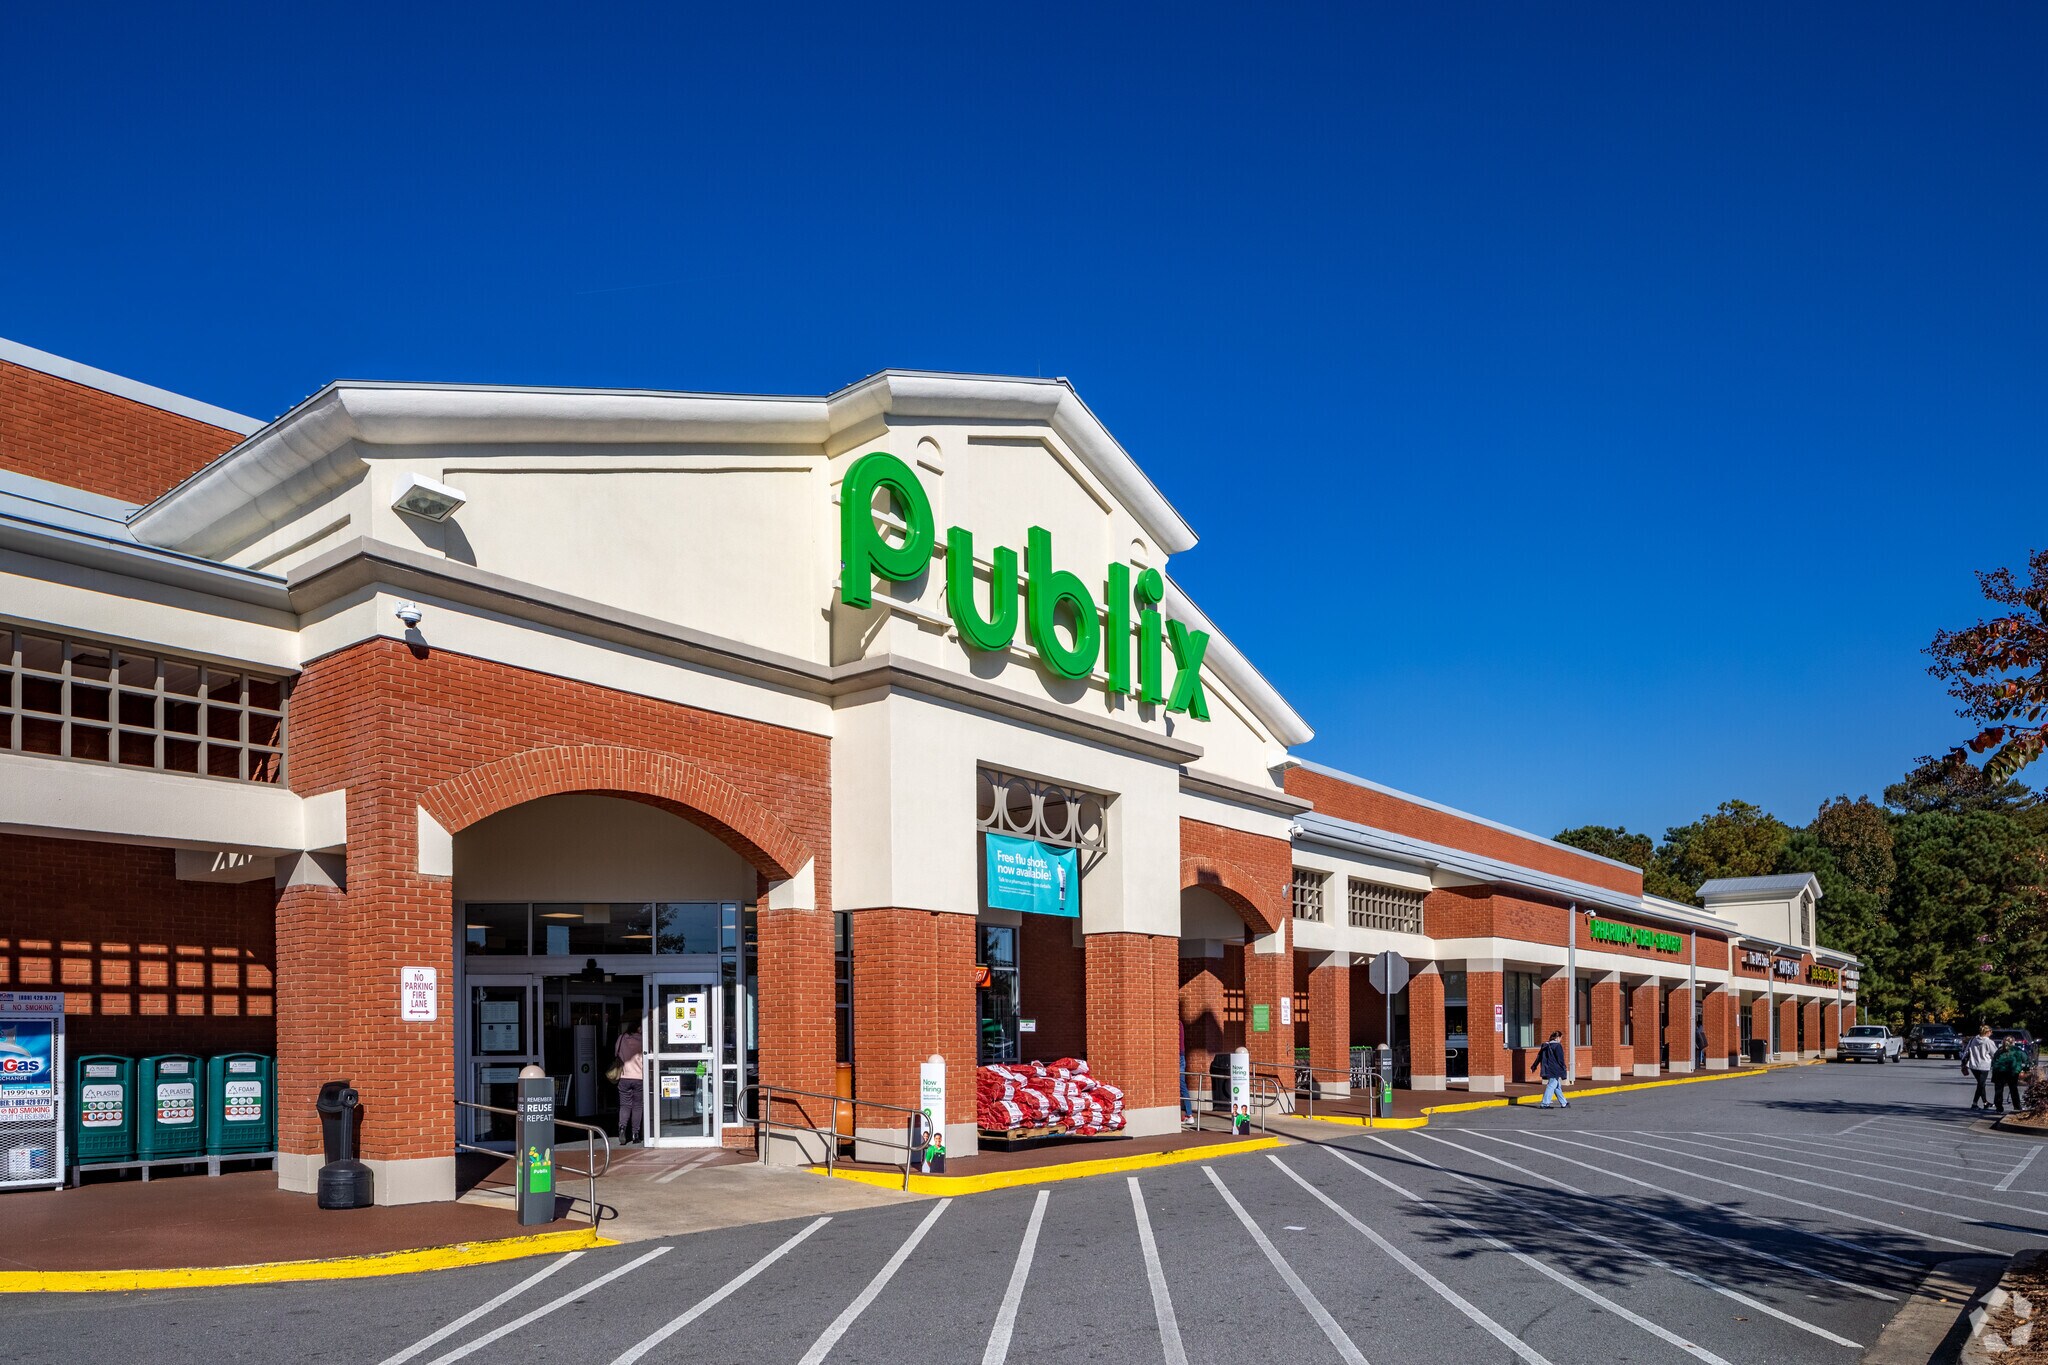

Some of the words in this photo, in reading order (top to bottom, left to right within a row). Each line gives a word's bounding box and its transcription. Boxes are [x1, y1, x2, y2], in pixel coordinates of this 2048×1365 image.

[841, 451, 1211, 721] Publix
[997, 850, 1014, 863] Free
[1015, 853, 1026, 865] flu
[1027, 855, 1048, 869] shots
[997, 864, 1015, 875] now
[1016, 867, 1052, 881] available!
[414, 973, 424, 982] NO
[404, 982, 433, 991] PARKING
[412, 991, 426, 999] FIRE
[411, 1000, 428, 1008] LANE
[923, 1085, 942, 1094] Hiring
[20, 1106, 50, 1114] SMOKING
[527, 1104, 552, 1112] REUSE
